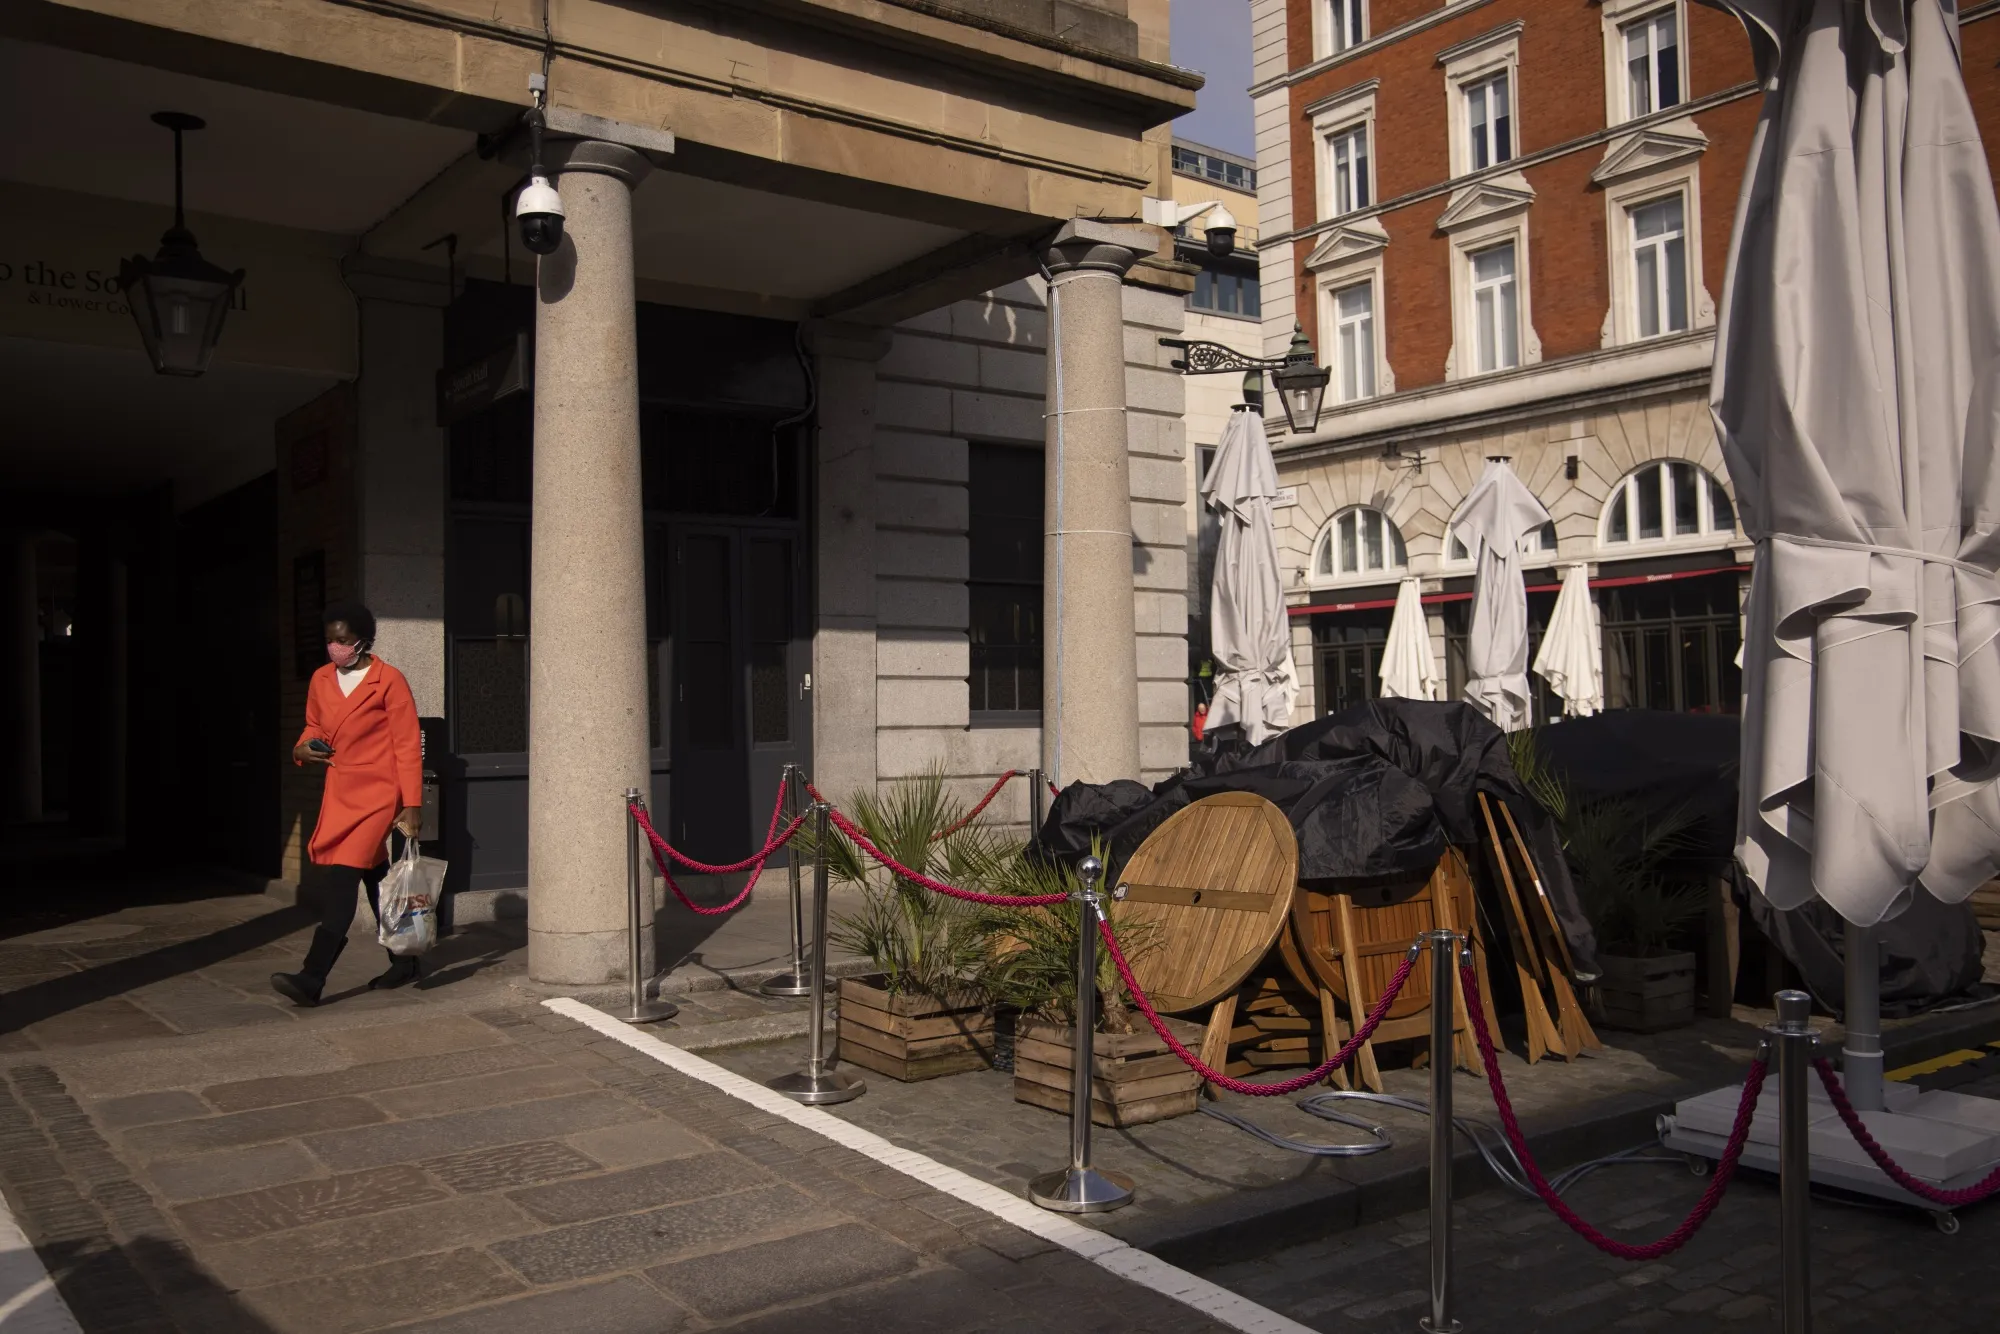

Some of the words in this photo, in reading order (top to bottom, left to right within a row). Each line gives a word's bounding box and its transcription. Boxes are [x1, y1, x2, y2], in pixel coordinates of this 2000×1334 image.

[24, 260, 76, 290] the
[28, 291, 41, 305] &
[46, 292, 106, 312] Lower
